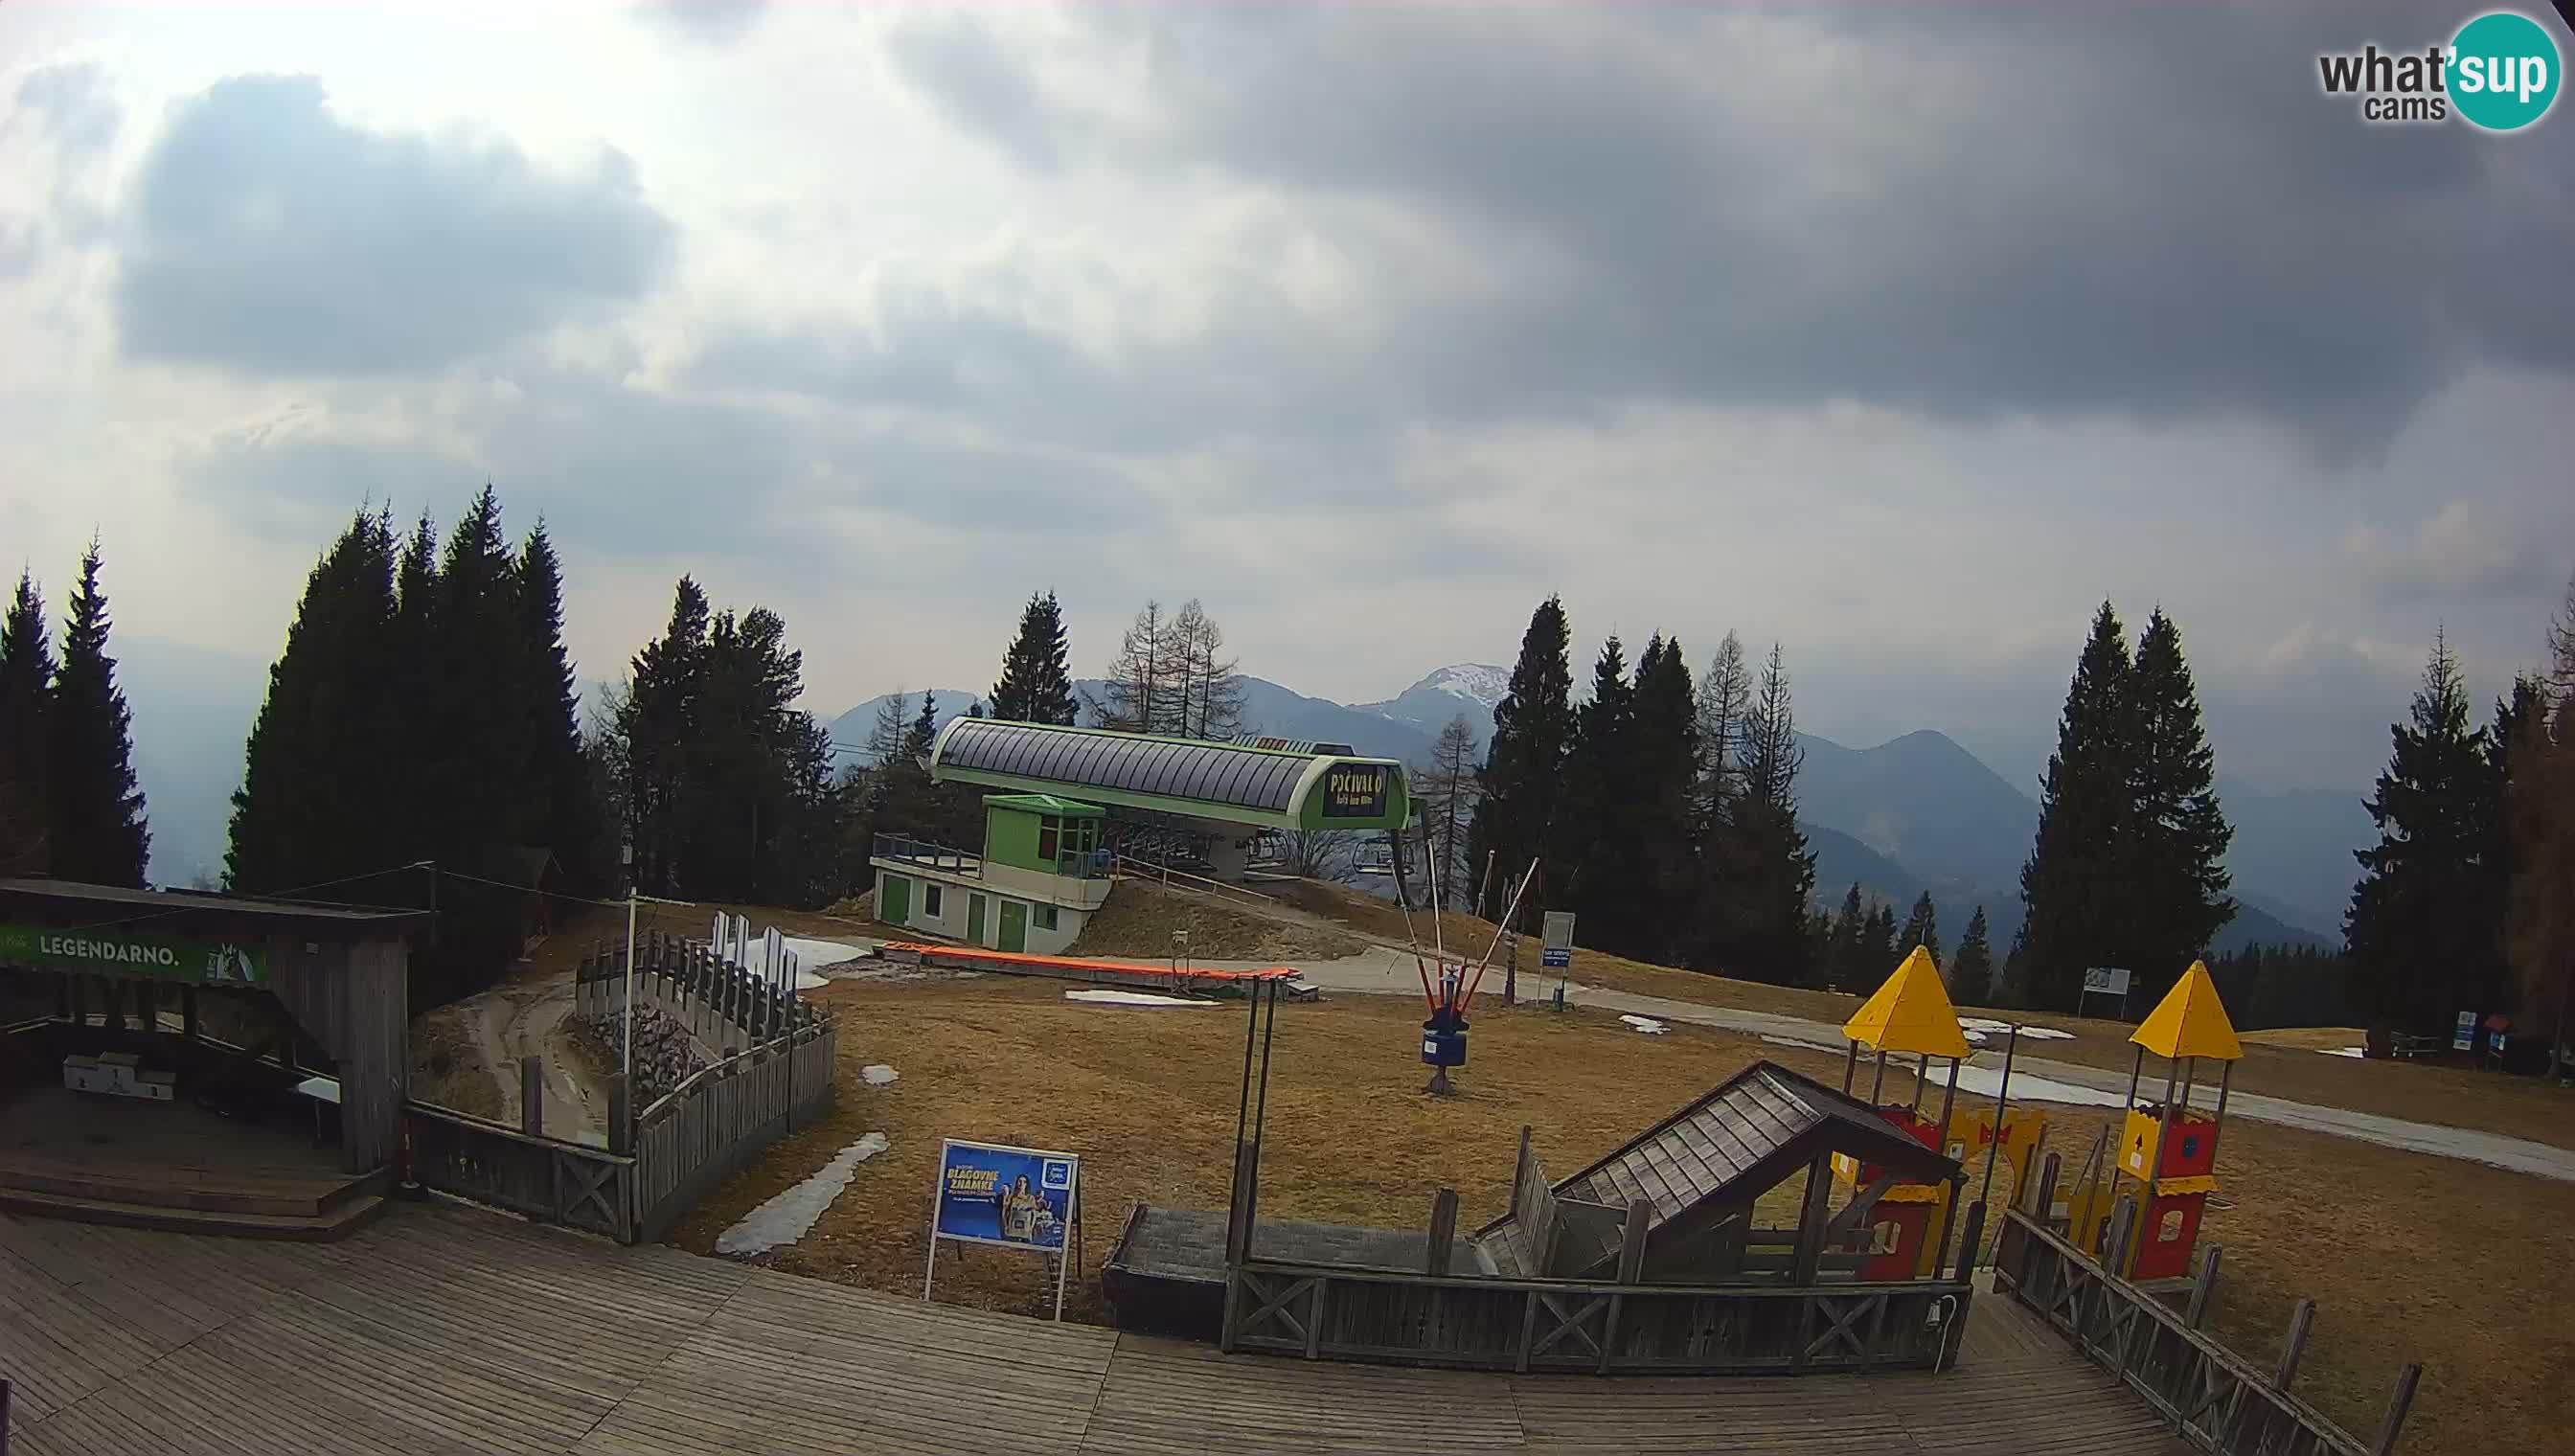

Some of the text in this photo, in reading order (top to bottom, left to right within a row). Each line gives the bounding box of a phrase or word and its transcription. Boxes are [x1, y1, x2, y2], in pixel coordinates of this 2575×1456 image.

[40, 936, 180, 967] LEGENDARNO.
[947, 1168, 998, 1181] BLAGOVNE
[949, 1178, 993, 1191] ZNAMKE
